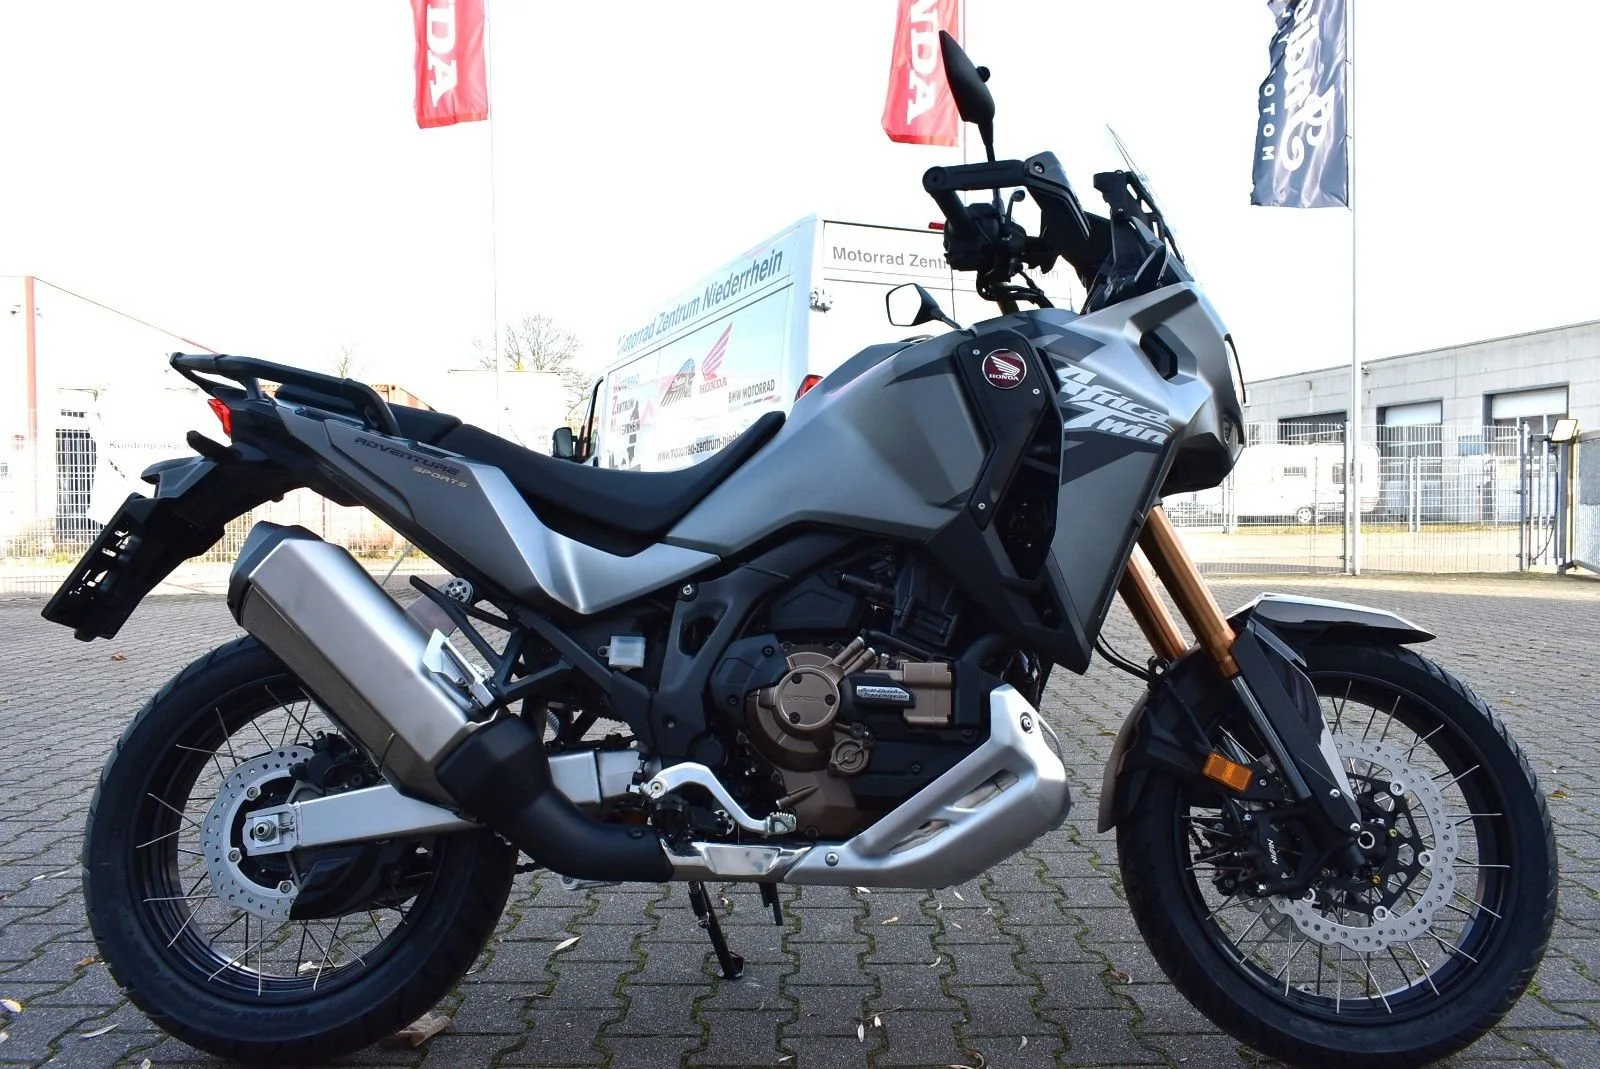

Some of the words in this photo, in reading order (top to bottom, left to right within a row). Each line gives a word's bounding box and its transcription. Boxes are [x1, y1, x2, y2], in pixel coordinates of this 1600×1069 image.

[427, 0, 458, 108] DA
[832, 246, 904, 266] Motorrad
[909, 254, 947, 270] Zentr
[656, 296, 700, 336] Zentrum
[702, 248, 783, 311] Niederrhein
[699, 376, 728, 394] HONDA
[742, 378, 775, 400] MOTORRAD
[990, 373, 1021, 382] HONDA
[1057, 363, 1172, 427] Africa
[1064, 400, 1176, 445] Twin
[354, 437, 460, 476] ADVENTURE
[412, 466, 469, 489] SPORTS
